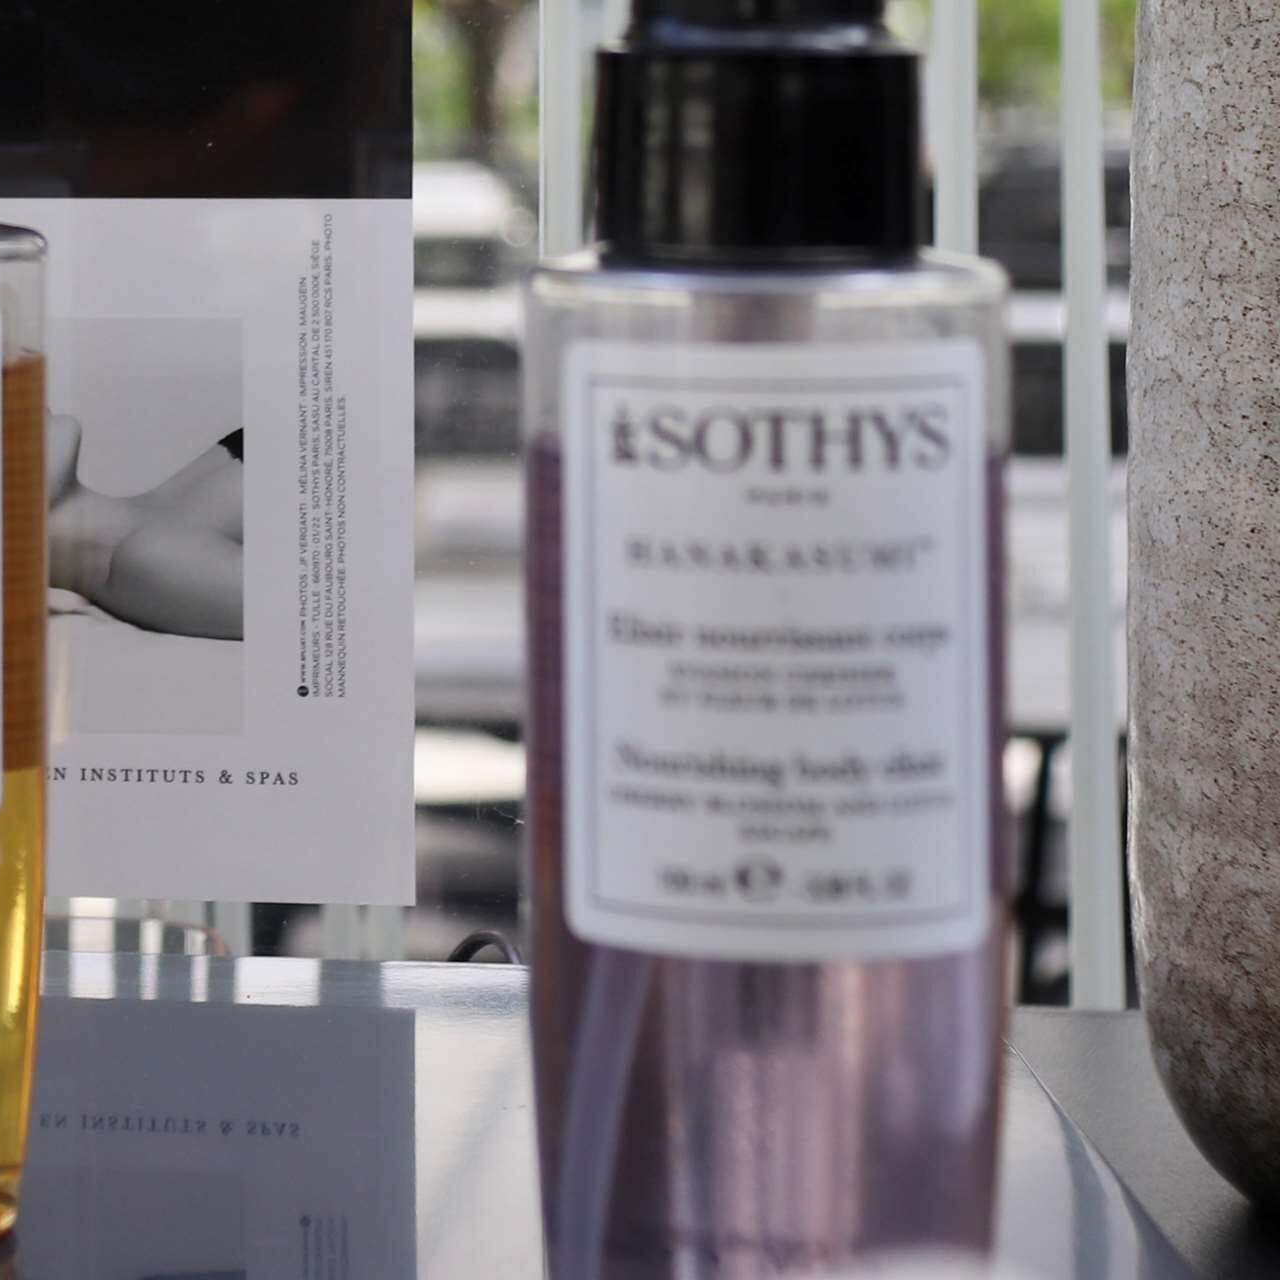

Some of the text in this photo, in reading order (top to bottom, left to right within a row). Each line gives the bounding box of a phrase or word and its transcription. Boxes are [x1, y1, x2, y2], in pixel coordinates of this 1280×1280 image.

[645, 405, 951, 474] SOTHYS
[46, 767, 299, 786] N INSTITUTS & SPAS
